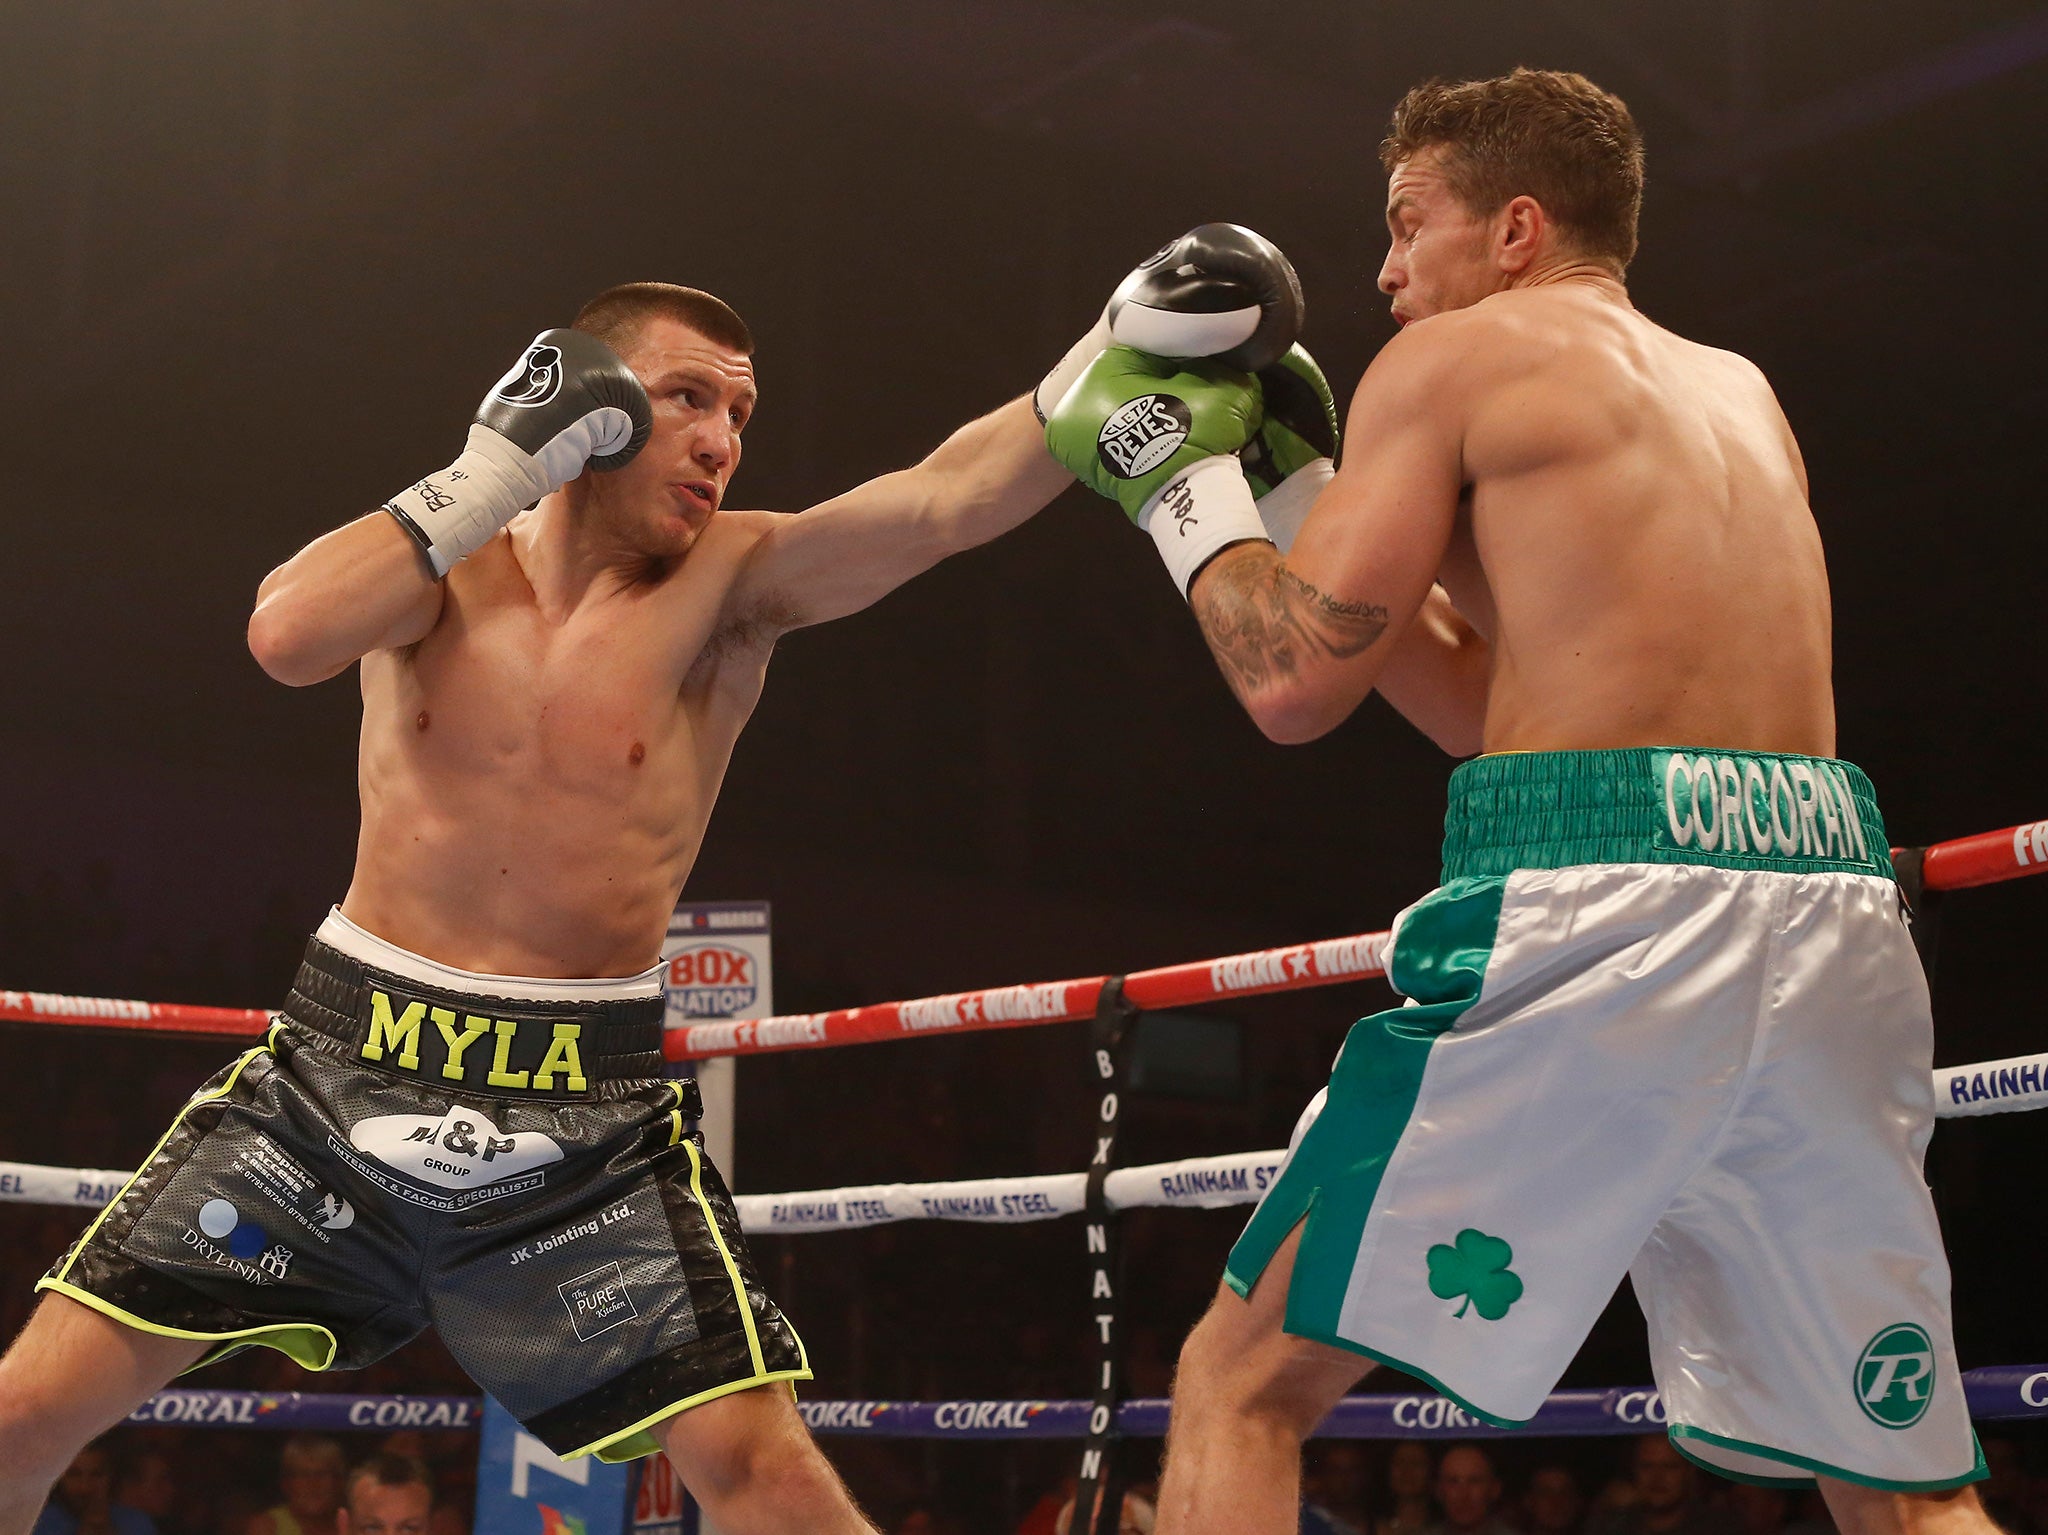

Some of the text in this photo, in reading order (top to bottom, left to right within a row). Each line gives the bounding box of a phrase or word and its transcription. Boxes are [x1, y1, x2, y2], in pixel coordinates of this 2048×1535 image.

[1105, 402, 1180, 476] REYES
[1665, 752, 1868, 861] CORCORAN
[670, 947, 749, 986] BOX
[669, 988, 752, 1014] NATION
[361, 990, 587, 1092] MYLA
[240, 1152, 250, 1162] &
[249, 1157, 283, 1189] Rescue
[252, 1150, 304, 1194] Access
[255, 1135, 316, 1190] Bespoke
[332, 1143, 539, 1210] INTERIOR & FACADE SPECIALISTS
[423, 1157, 471, 1178] GROUP
[1160, 1168, 1250, 1198] RAINHAM
[231, 1160, 245, 1174] Tel:
[244, 1170, 264, 1194] 07795
[262, 1185, 286, 1211] 557243
[287, 1207, 309, 1227] 07789
[306, 1220, 331, 1244] 511835
[845, 1200, 894, 1222] STEEL
[1001, 1193, 1059, 1217] STEEL
[509, 1204, 636, 1266] JK Jointing Ltd.
[571, 1289, 588, 1300] The
[576, 1285, 617, 1315] PURE
[595, 1300, 626, 1319] Kitchen
[349, 1398, 470, 1427] CORAL
[934, 1401, 1031, 1430] CORAL
